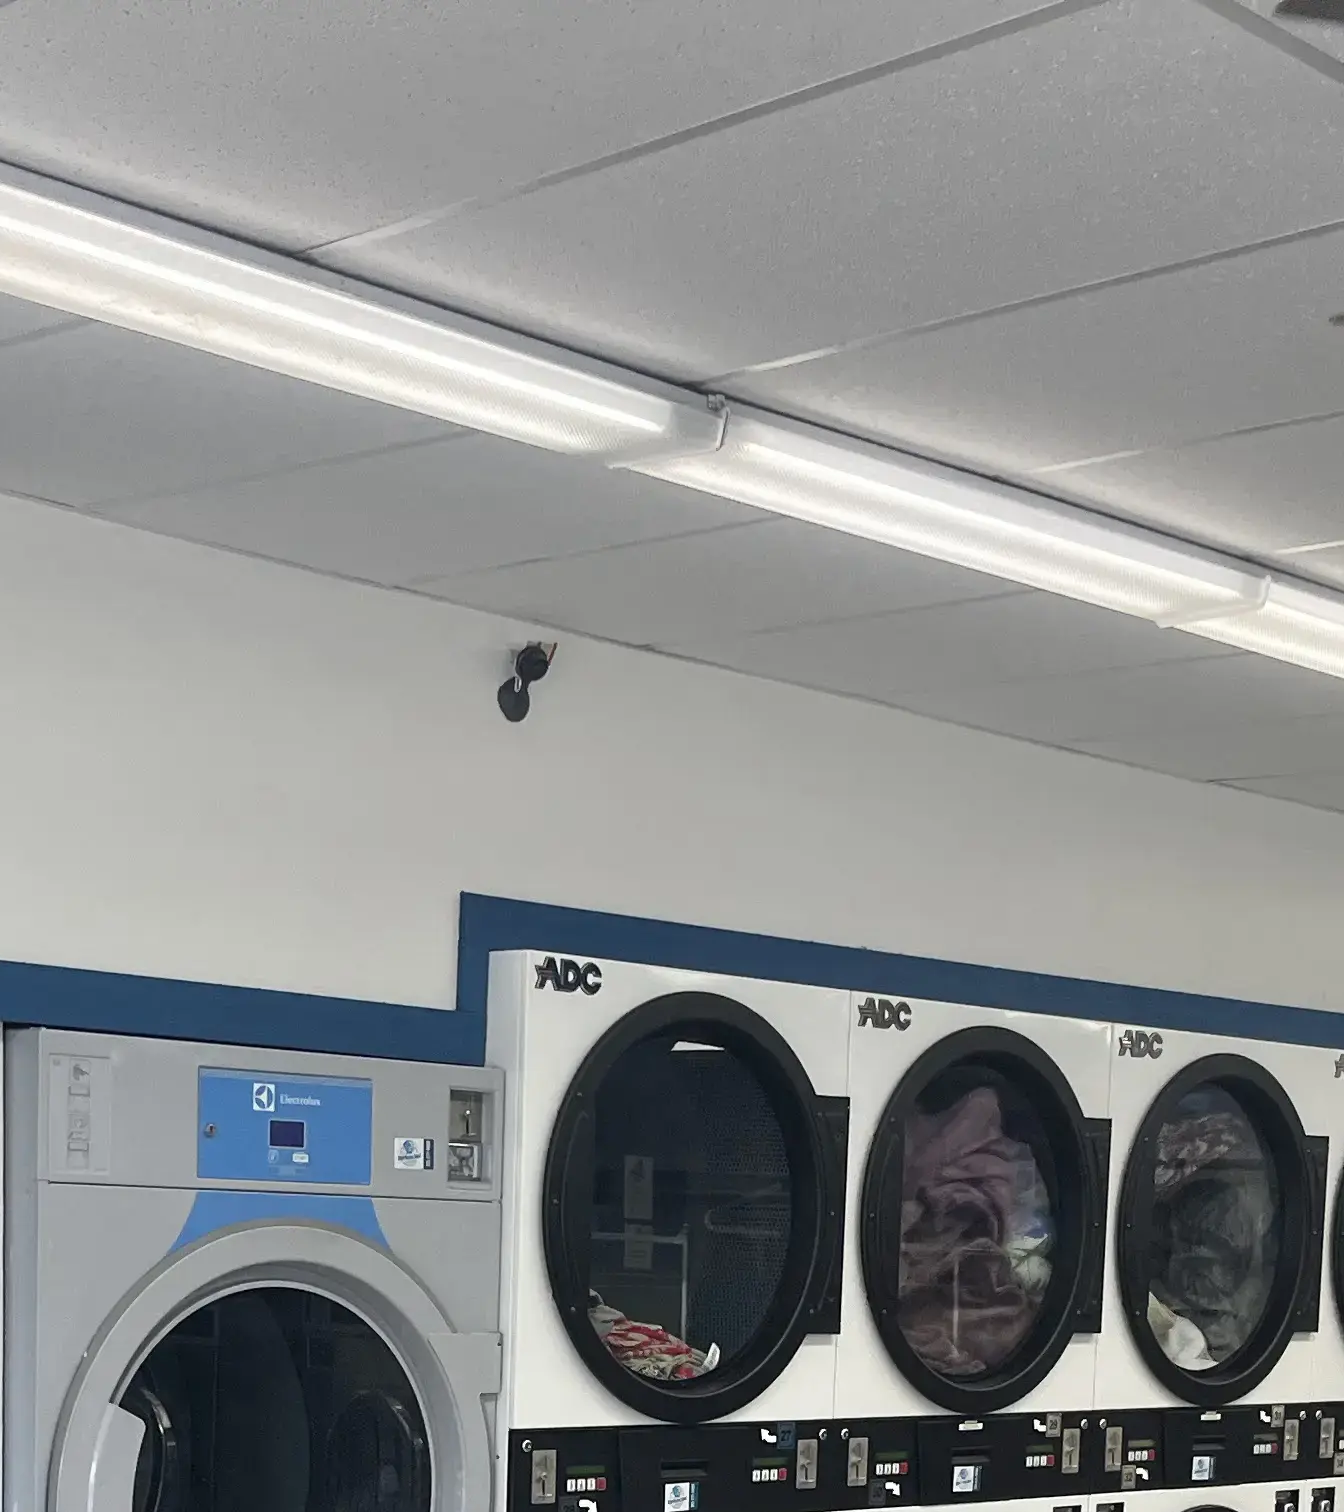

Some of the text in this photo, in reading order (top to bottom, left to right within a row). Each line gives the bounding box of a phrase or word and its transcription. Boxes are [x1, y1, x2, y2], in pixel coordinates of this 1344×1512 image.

[534, 956, 602, 996] ADC
[858, 997, 912, 1032] ADC
[1119, 1029, 1164, 1059] ADC
[280, 1094, 321, 1106] Electrolux
[780, 1429, 793, 1442] 27
